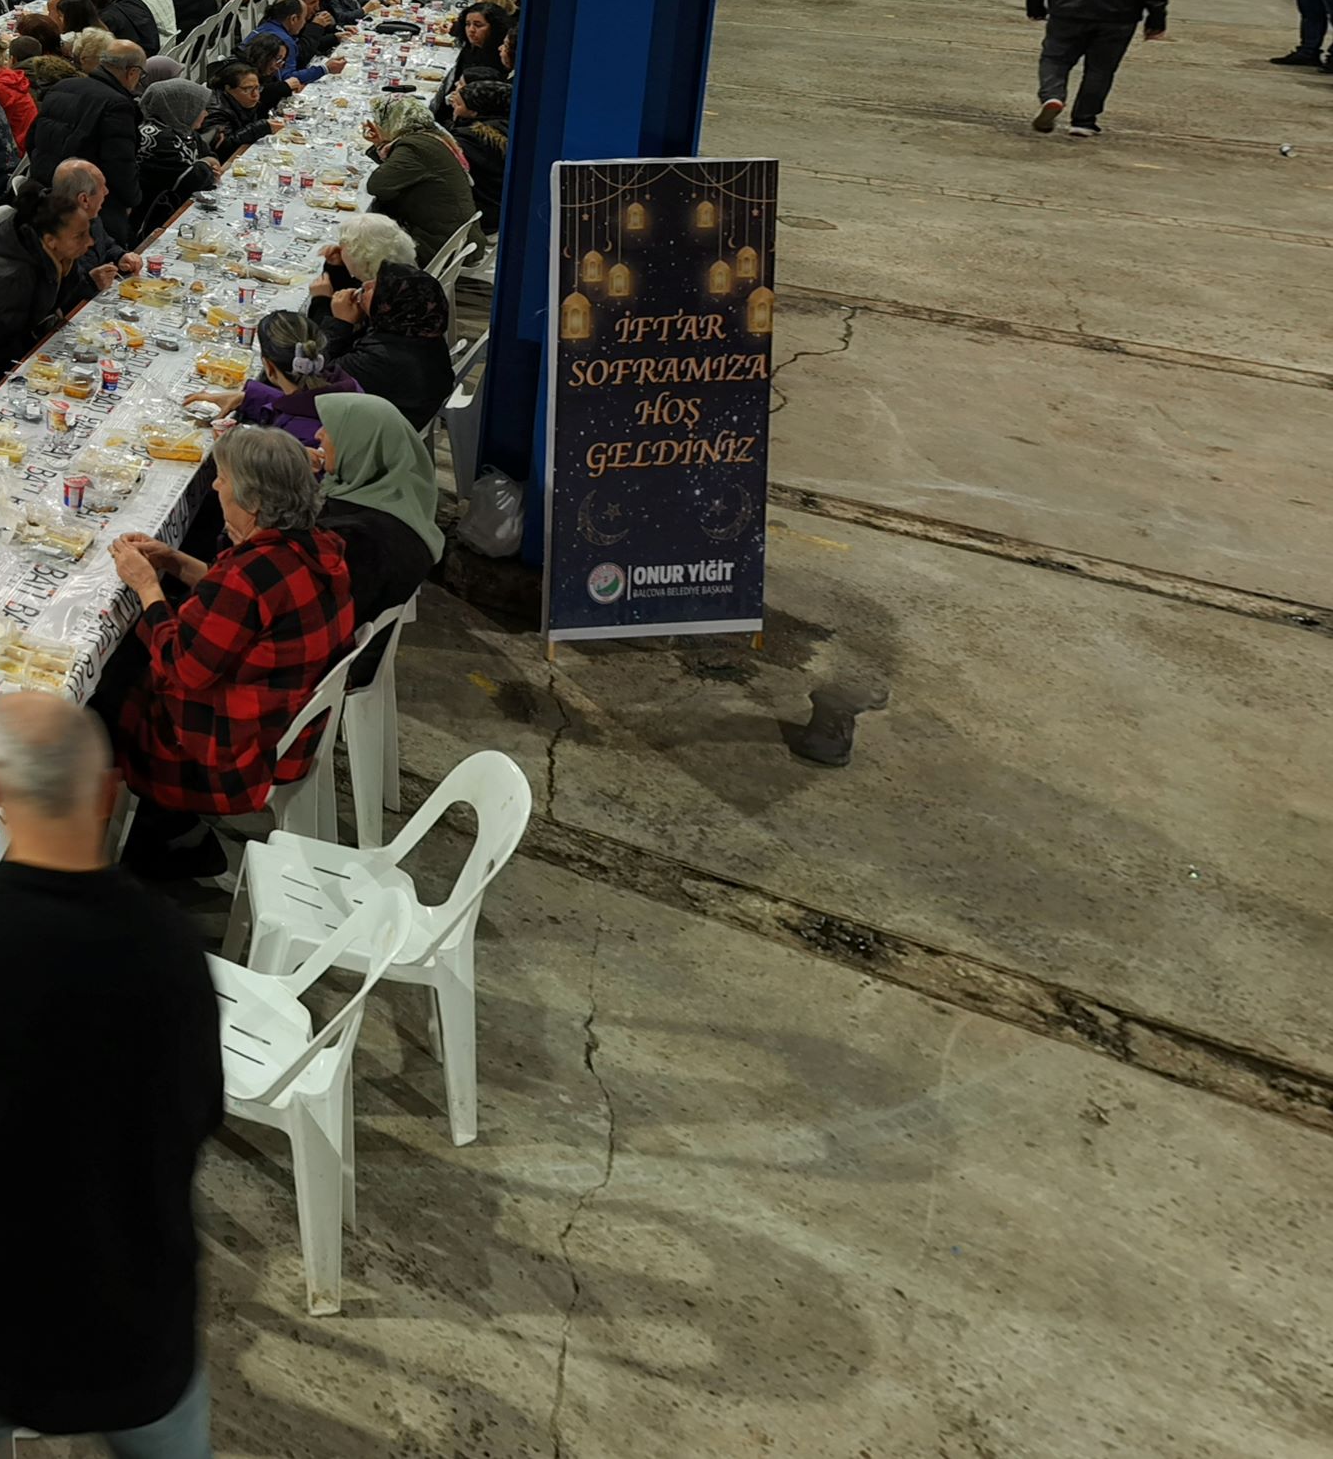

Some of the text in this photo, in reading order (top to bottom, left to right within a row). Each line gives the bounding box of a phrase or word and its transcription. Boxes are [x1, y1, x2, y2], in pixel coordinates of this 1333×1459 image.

[614, 308, 726, 343] İFTAR
[568, 353, 768, 387] SOFRAMIZA
[635, 391, 702, 430] HOŞ
[586, 430, 756, 478] GELDİNİZ
[633, 559, 734, 585] ONUR YİĞİT
